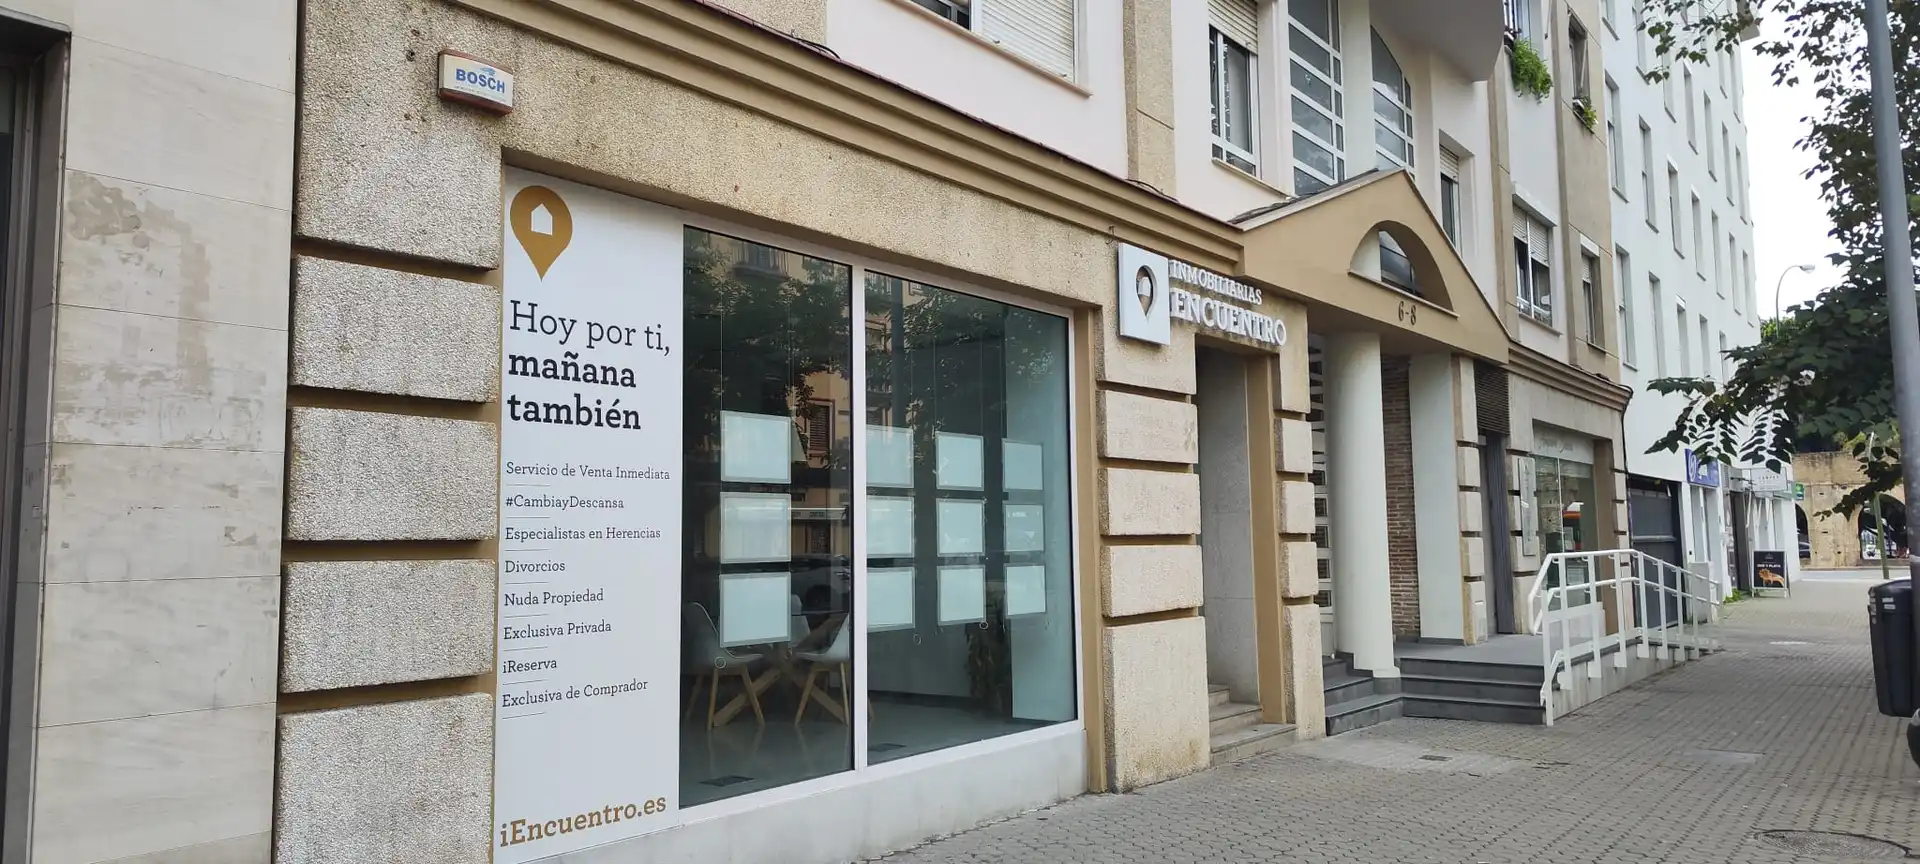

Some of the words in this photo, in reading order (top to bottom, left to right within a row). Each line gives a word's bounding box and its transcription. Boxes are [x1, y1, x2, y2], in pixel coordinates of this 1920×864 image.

[456, 68, 505, 93] BOSCH
[1168, 259, 1263, 306] INMOBILIARIAS
[1170, 287, 1287, 346] ENCUENTRO
[1398, 300, 1417, 326] 6-8
[510, 299, 577, 345] Hoy
[586, 321, 637, 349] por
[644, 323, 670, 357] ti,
[508, 351, 637, 388] mañana
[506, 392, 641, 430] también
[506, 461, 558, 476] Servicio
[560, 463, 576, 477] de
[579, 464, 613, 478] Venta
[615, 466, 671, 480] Inmediata
[505, 494, 625, 511] #CambiayDescansa
[505, 525, 586, 543] Especialistas
[588, 529, 603, 540] en
[605, 526, 661, 540] Herencias
[504, 559, 566, 573] Divorcios
[504, 591, 539, 606] Nuda
[543, 588, 604, 606] Propiedad
[503, 624, 564, 640] Exclusiva
[567, 619, 612, 635] Privada
[502, 659, 557, 674] iReserva
[502, 690, 563, 708] Exclusiva
[565, 686, 581, 700] de
[583, 678, 649, 697] Comprador
[499, 796, 667, 848] iEncuentro.es
